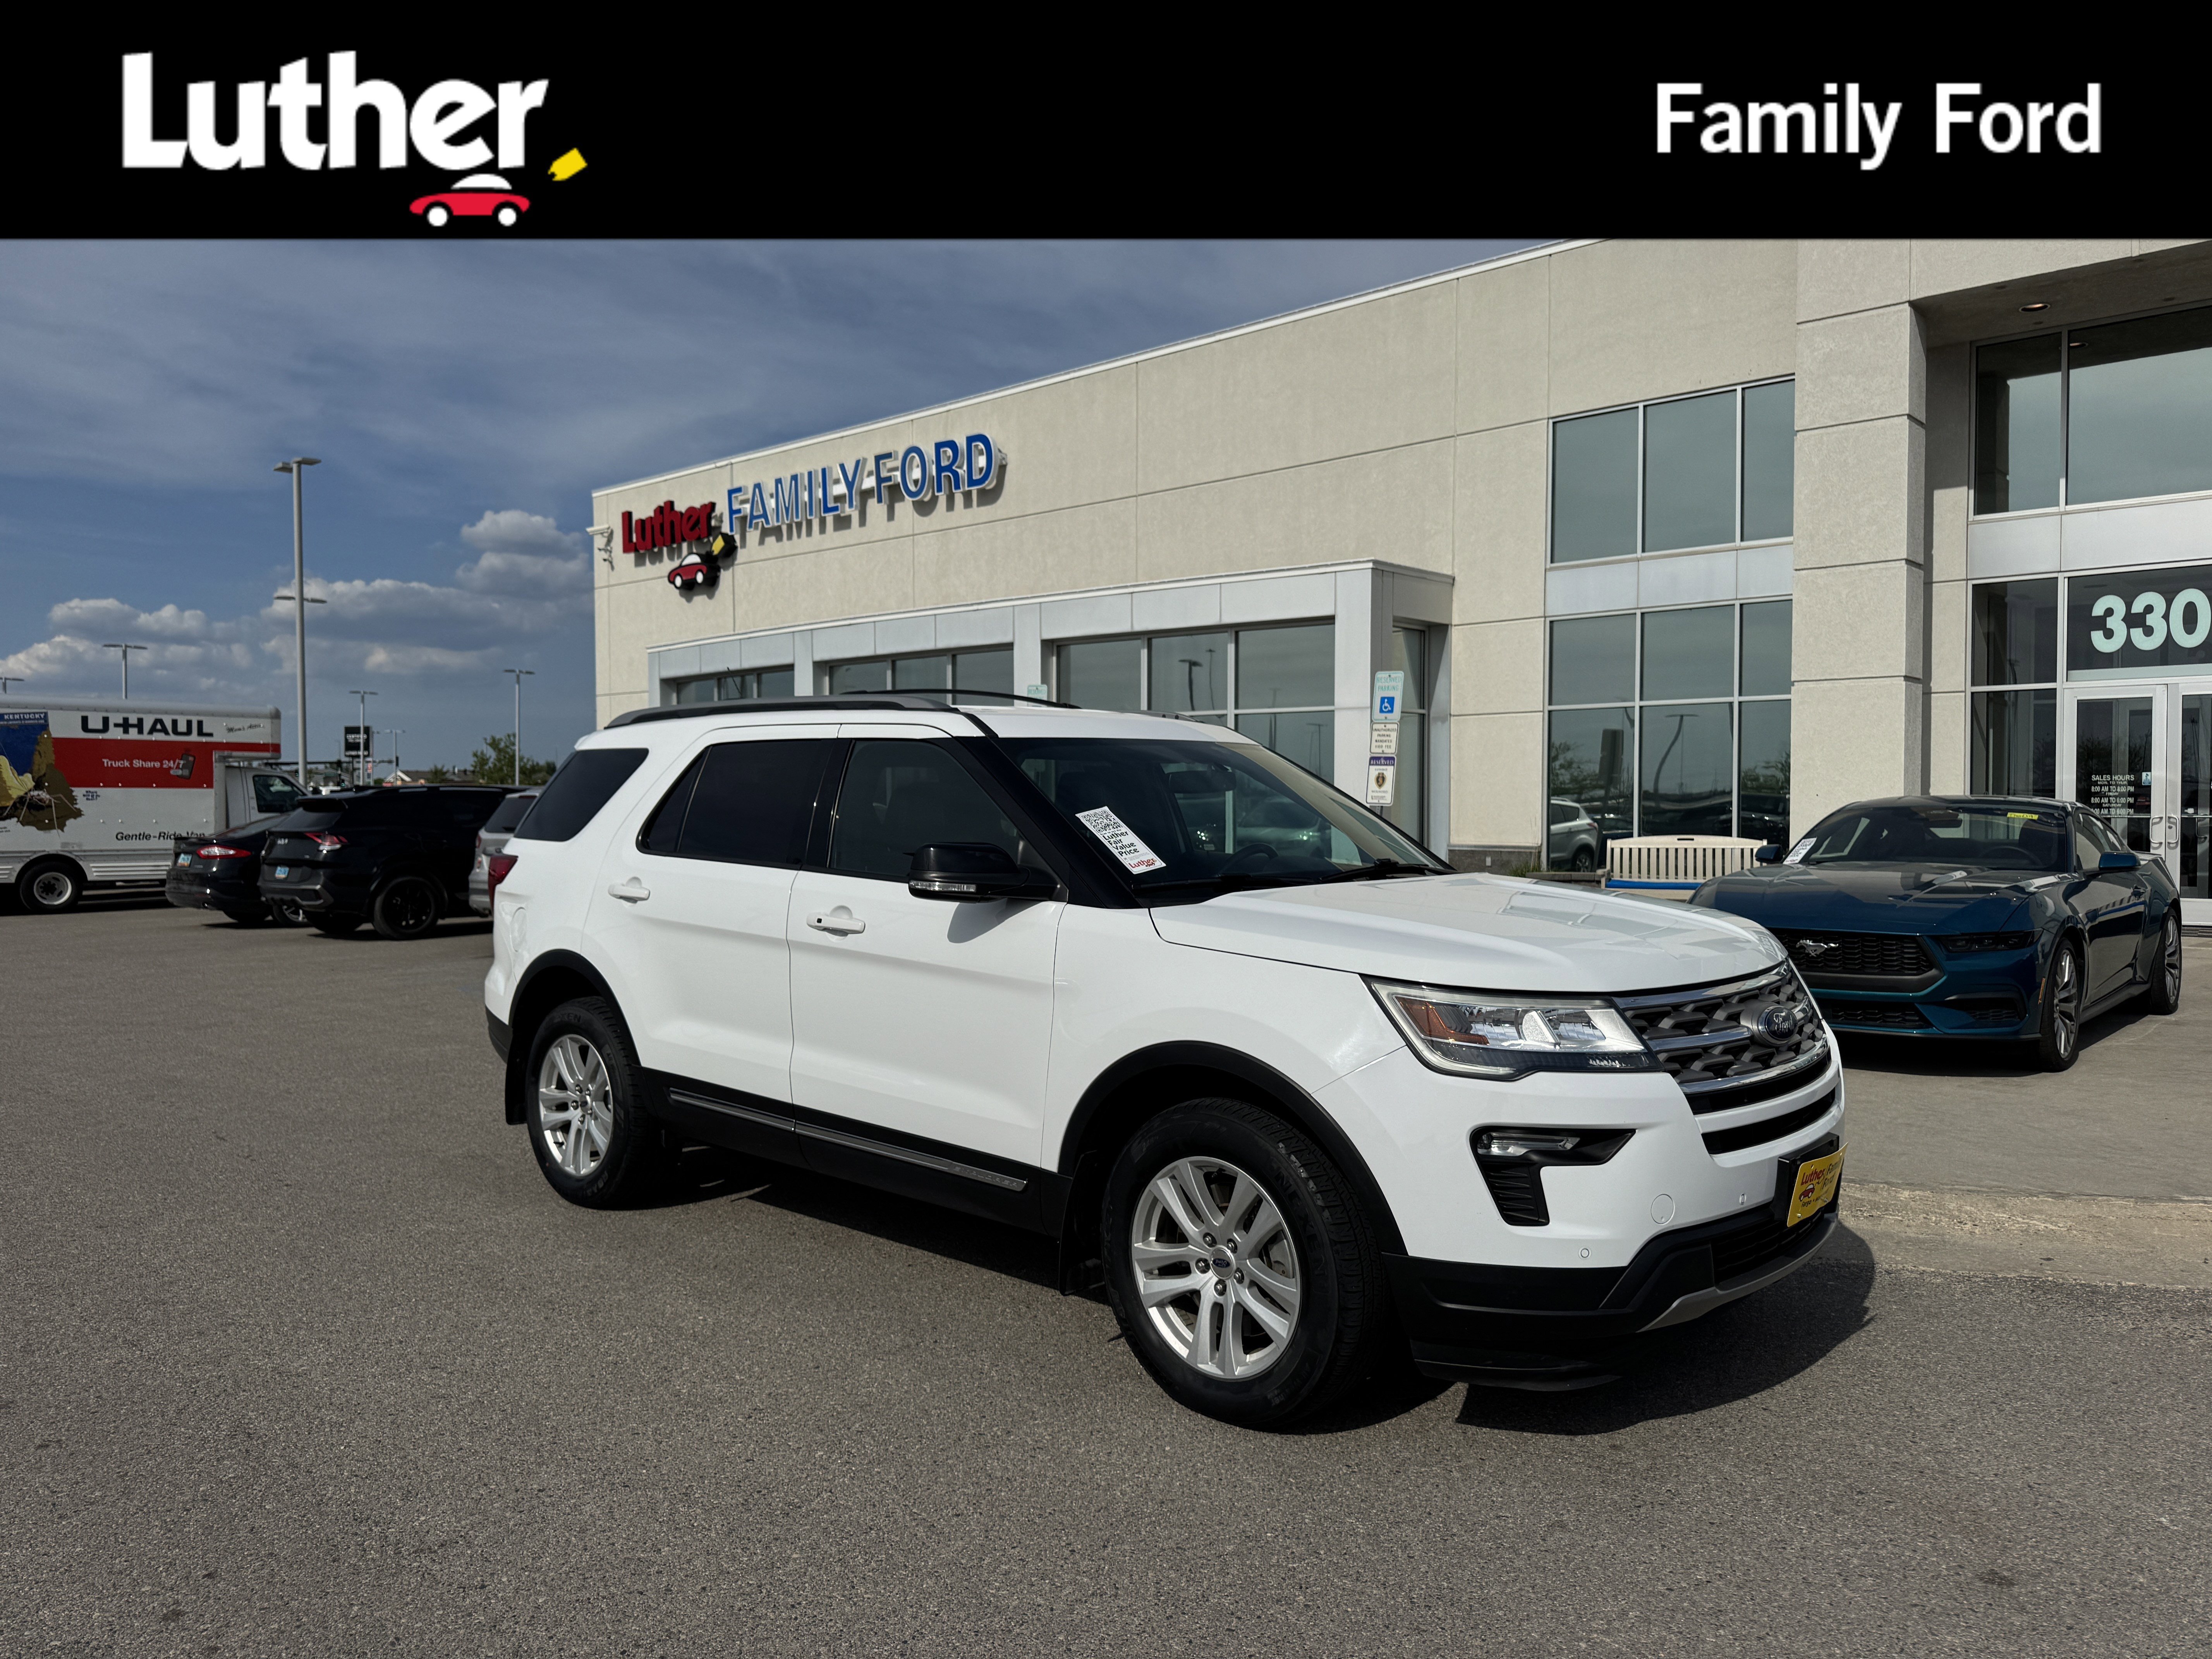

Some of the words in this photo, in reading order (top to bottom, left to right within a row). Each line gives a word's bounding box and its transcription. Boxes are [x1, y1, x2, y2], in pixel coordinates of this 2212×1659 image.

[622, 500, 716, 554] Luther
[727, 457, 867, 535] FAMILY
[874, 433, 995, 504] FORD
[81, 716, 213, 737] U-HAUL
[102, 758, 130, 768] Truck
[133, 759, 160, 768] Share
[163, 758, 185, 769] 24/7
[1103, 831, 1128, 840] Luther
[1118, 848, 1139, 857] Price
[1128, 858, 1156, 868] Luther
[1774, 1012, 1795, 1035] Ford
[1801, 1168, 1826, 1186] Luther
